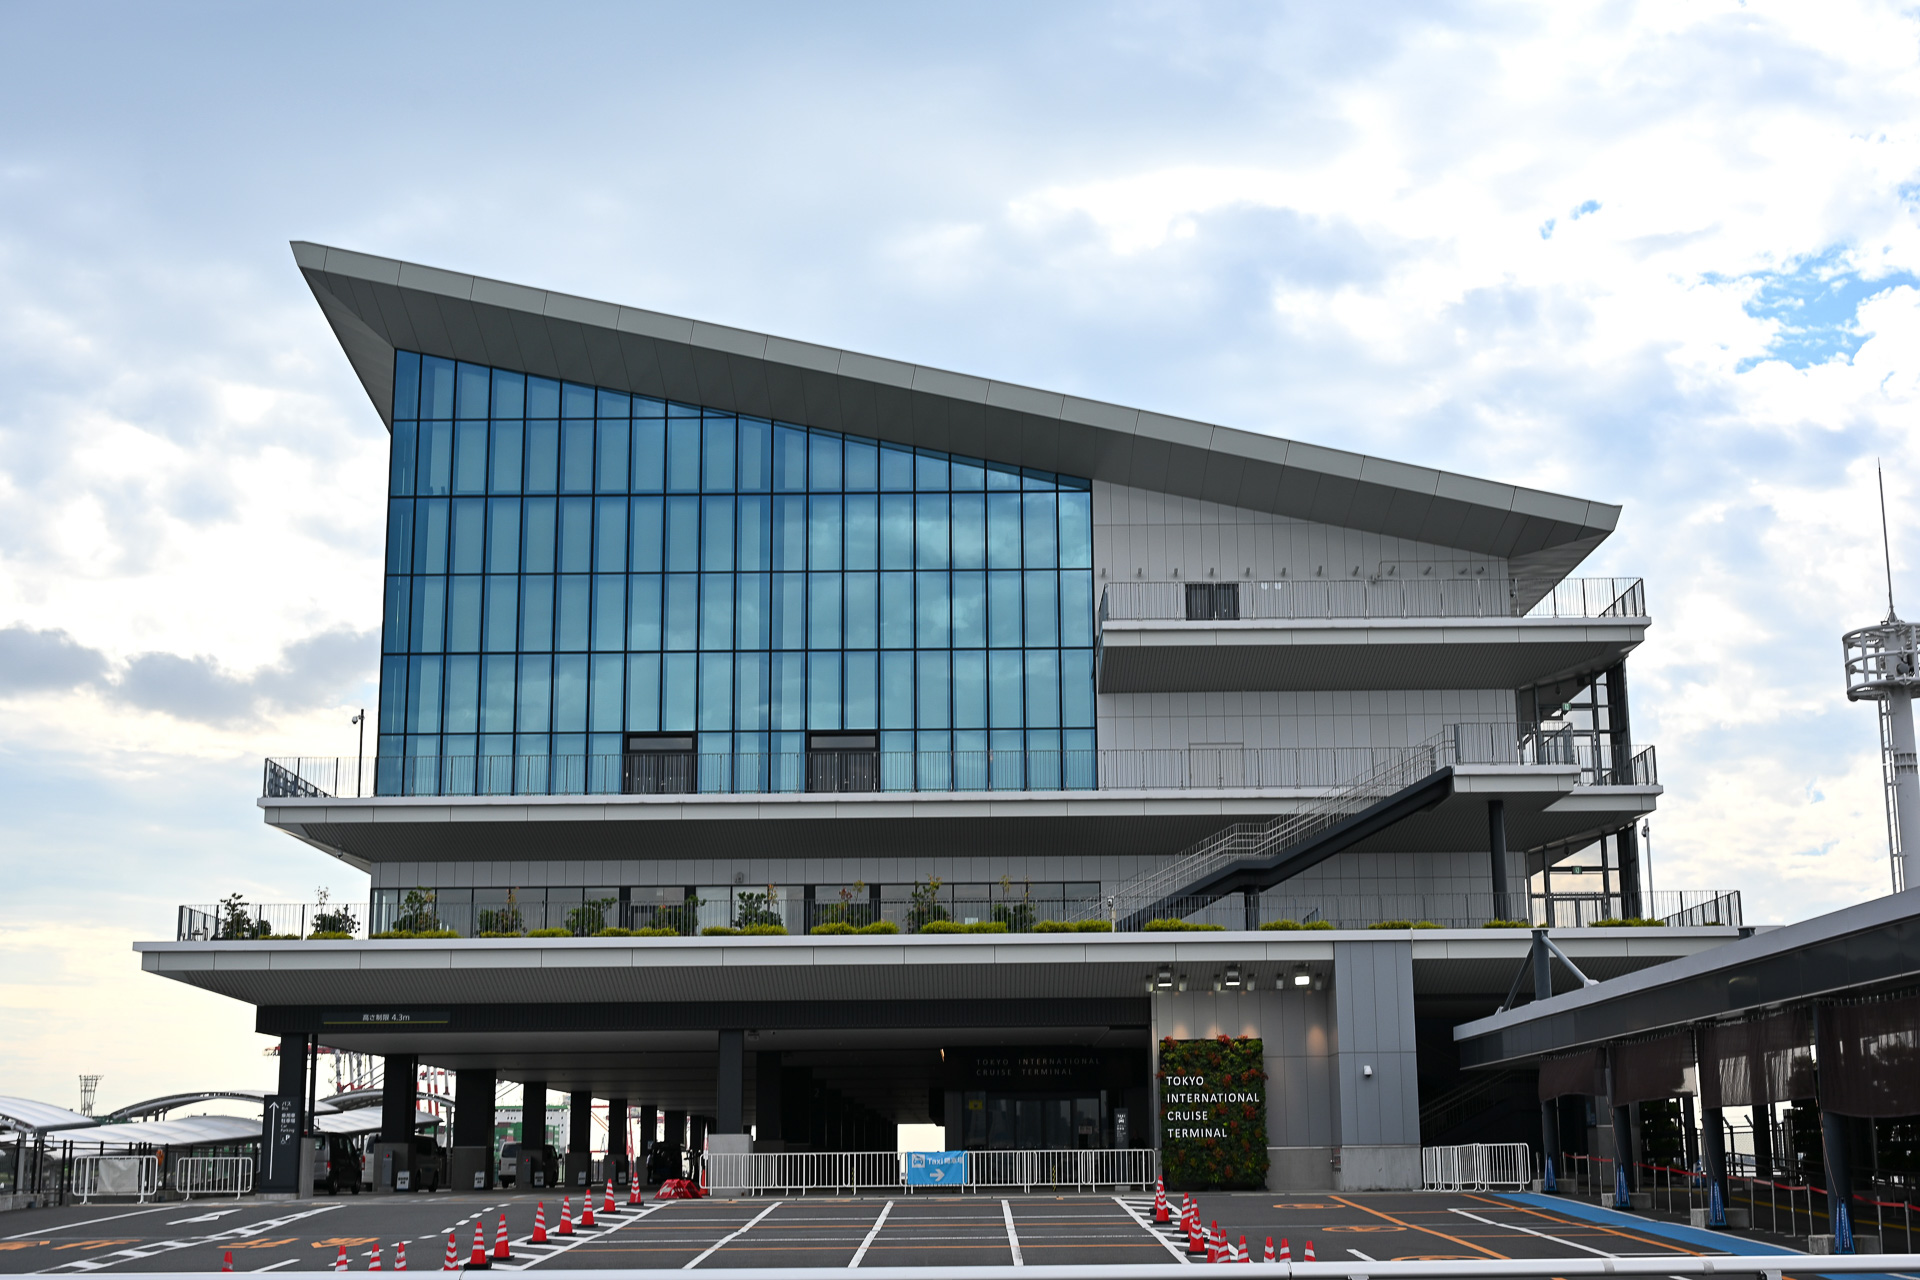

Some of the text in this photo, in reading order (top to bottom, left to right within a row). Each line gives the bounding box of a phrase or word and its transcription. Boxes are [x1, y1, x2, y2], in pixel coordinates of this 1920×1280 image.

[362, 1013, 411, 1022] 高さ制限 4.3m
[976, 1057, 1099, 1066] TOKYO INTERNATIONAL
[976, 1068, 1073, 1077] CRUISE TERMINAL
[1166, 1076, 1204, 1086] TOKYO
[1167, 1092, 1260, 1103] INTERNATIONAL
[1167, 1111, 1208, 1121] CRUISE
[1168, 1128, 1228, 1138] TERMINAL
